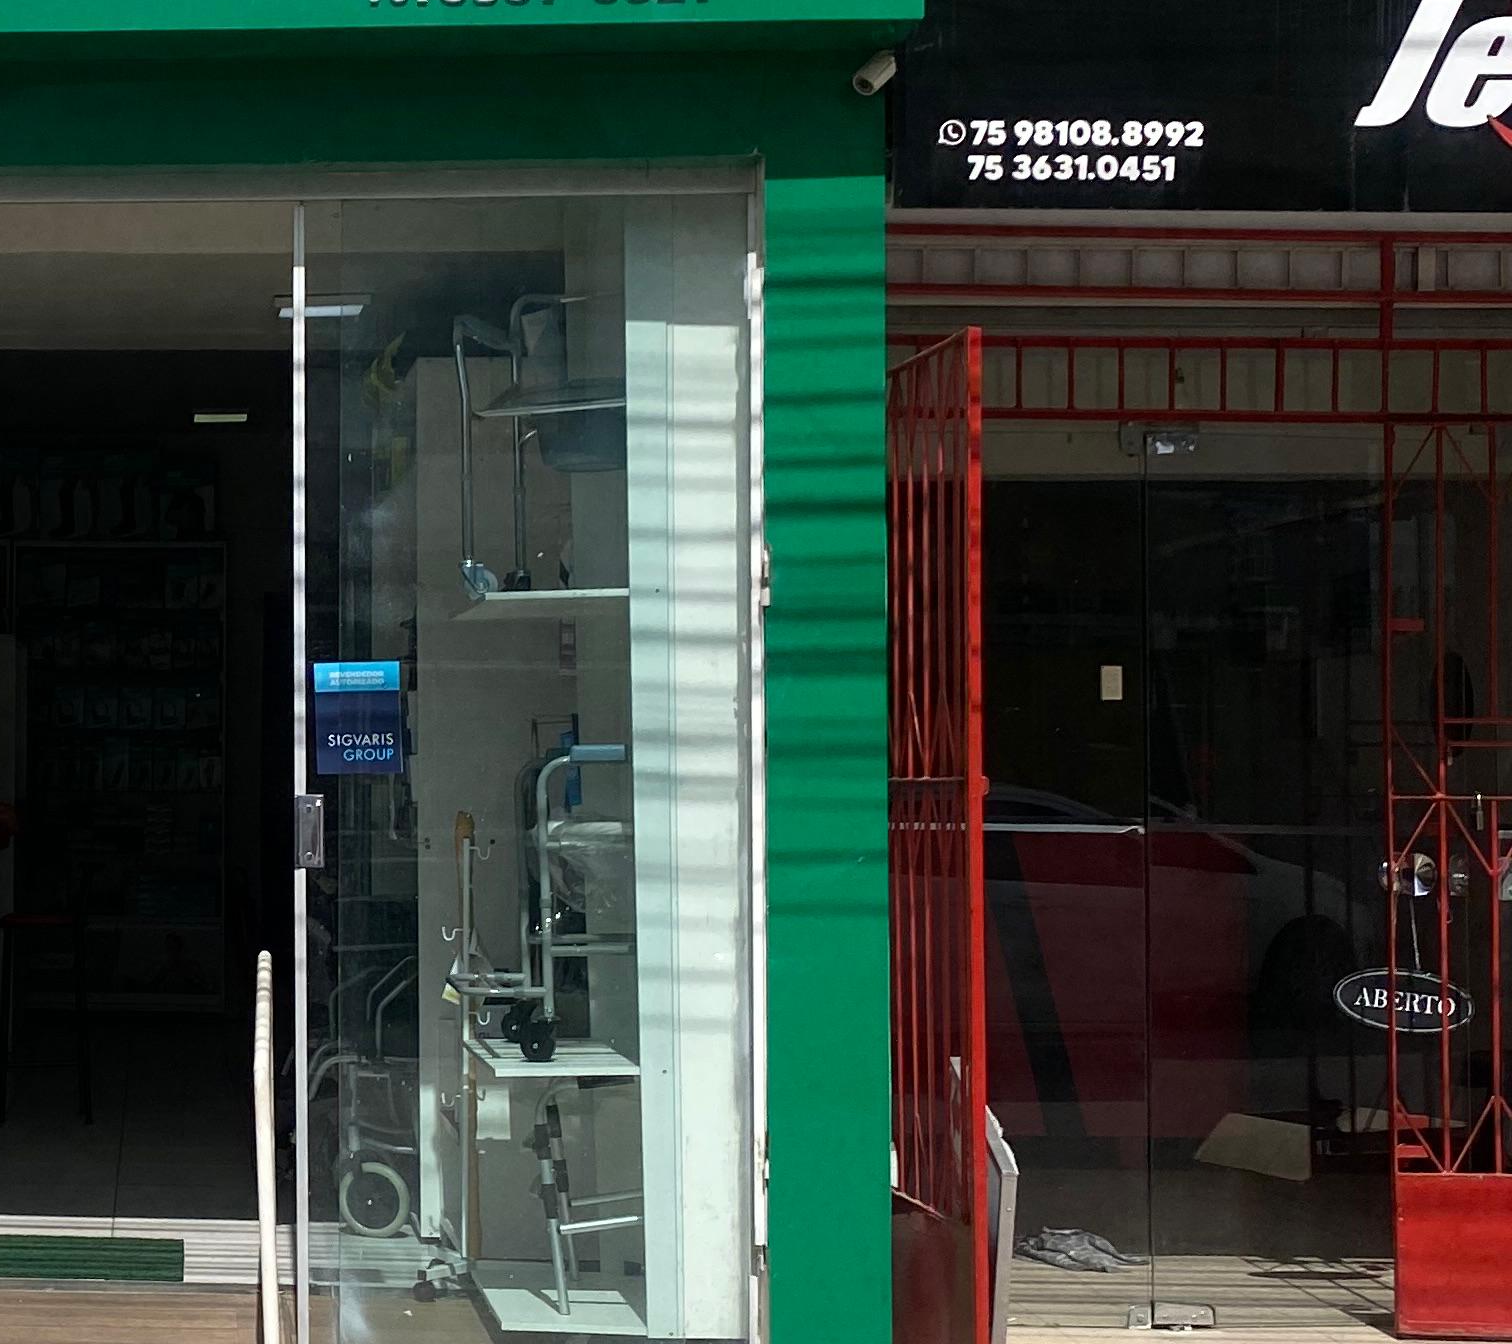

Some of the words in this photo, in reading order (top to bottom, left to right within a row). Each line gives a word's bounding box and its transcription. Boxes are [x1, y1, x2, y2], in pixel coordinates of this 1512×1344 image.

[970, 120, 1006, 146] 75
[1015, 120, 1205, 148] 98108.8992
[967, 155, 1004, 182] 75
[1011, 155, 1176, 182] 3631.0451
[327, 732, 394, 747] SIGVARIS
[343, 748, 394, 761] GROUP
[1354, 987, 1456, 1017] ABERTO
